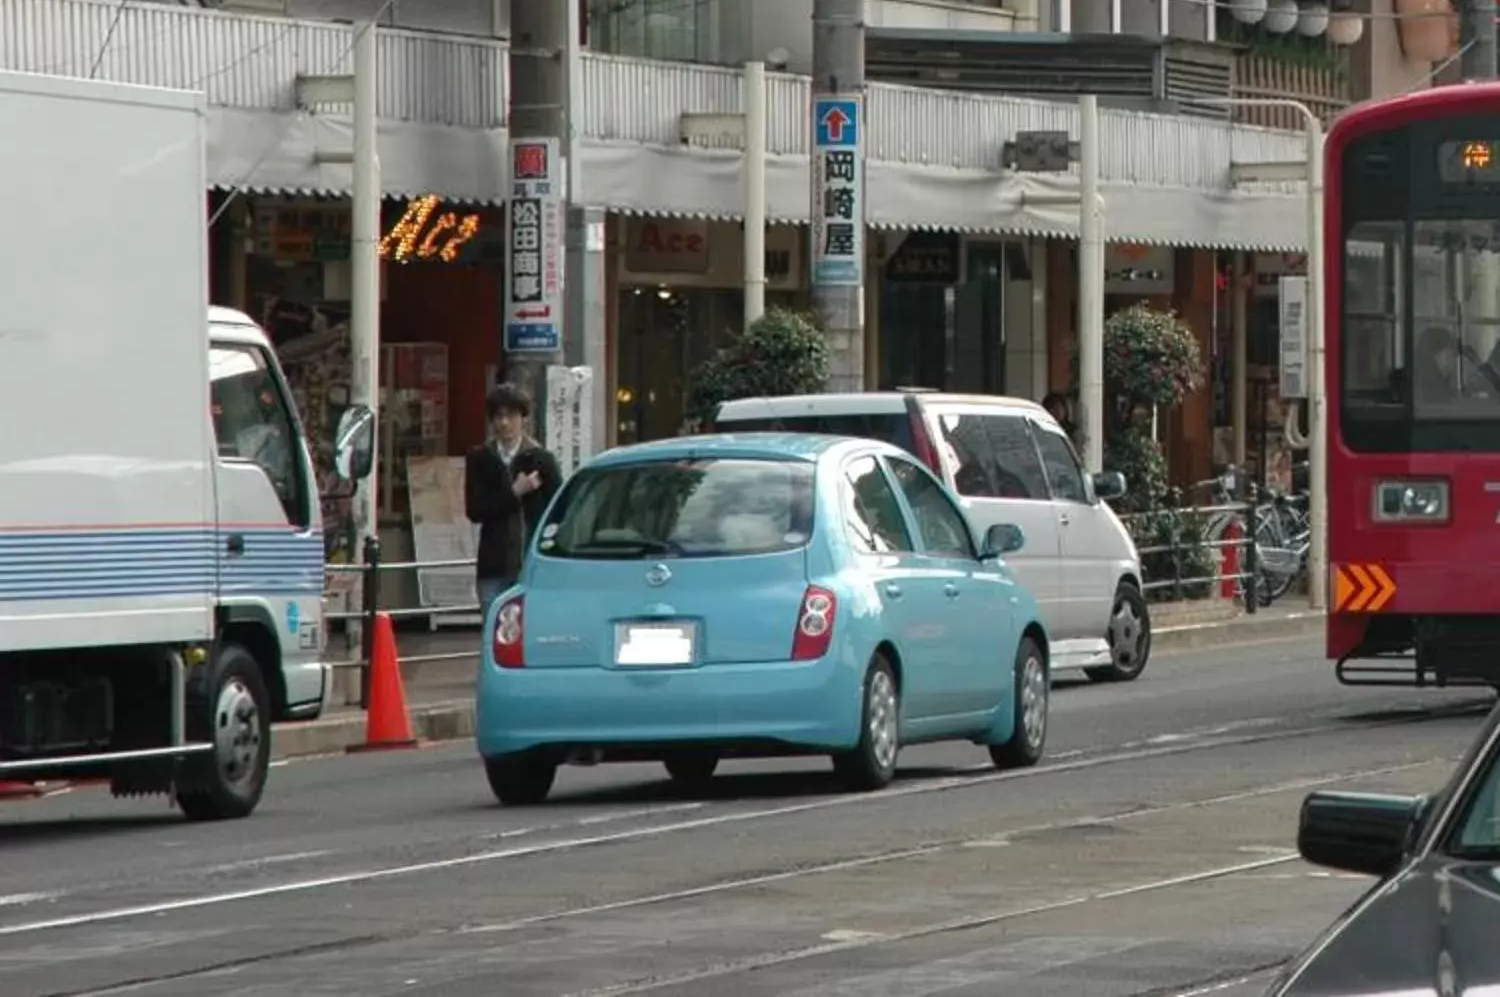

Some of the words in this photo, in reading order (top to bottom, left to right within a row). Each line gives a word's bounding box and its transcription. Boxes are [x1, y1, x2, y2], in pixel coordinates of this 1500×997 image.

[375, 193, 480, 265] Ace
[512, 201, 541, 301] 松田商事
